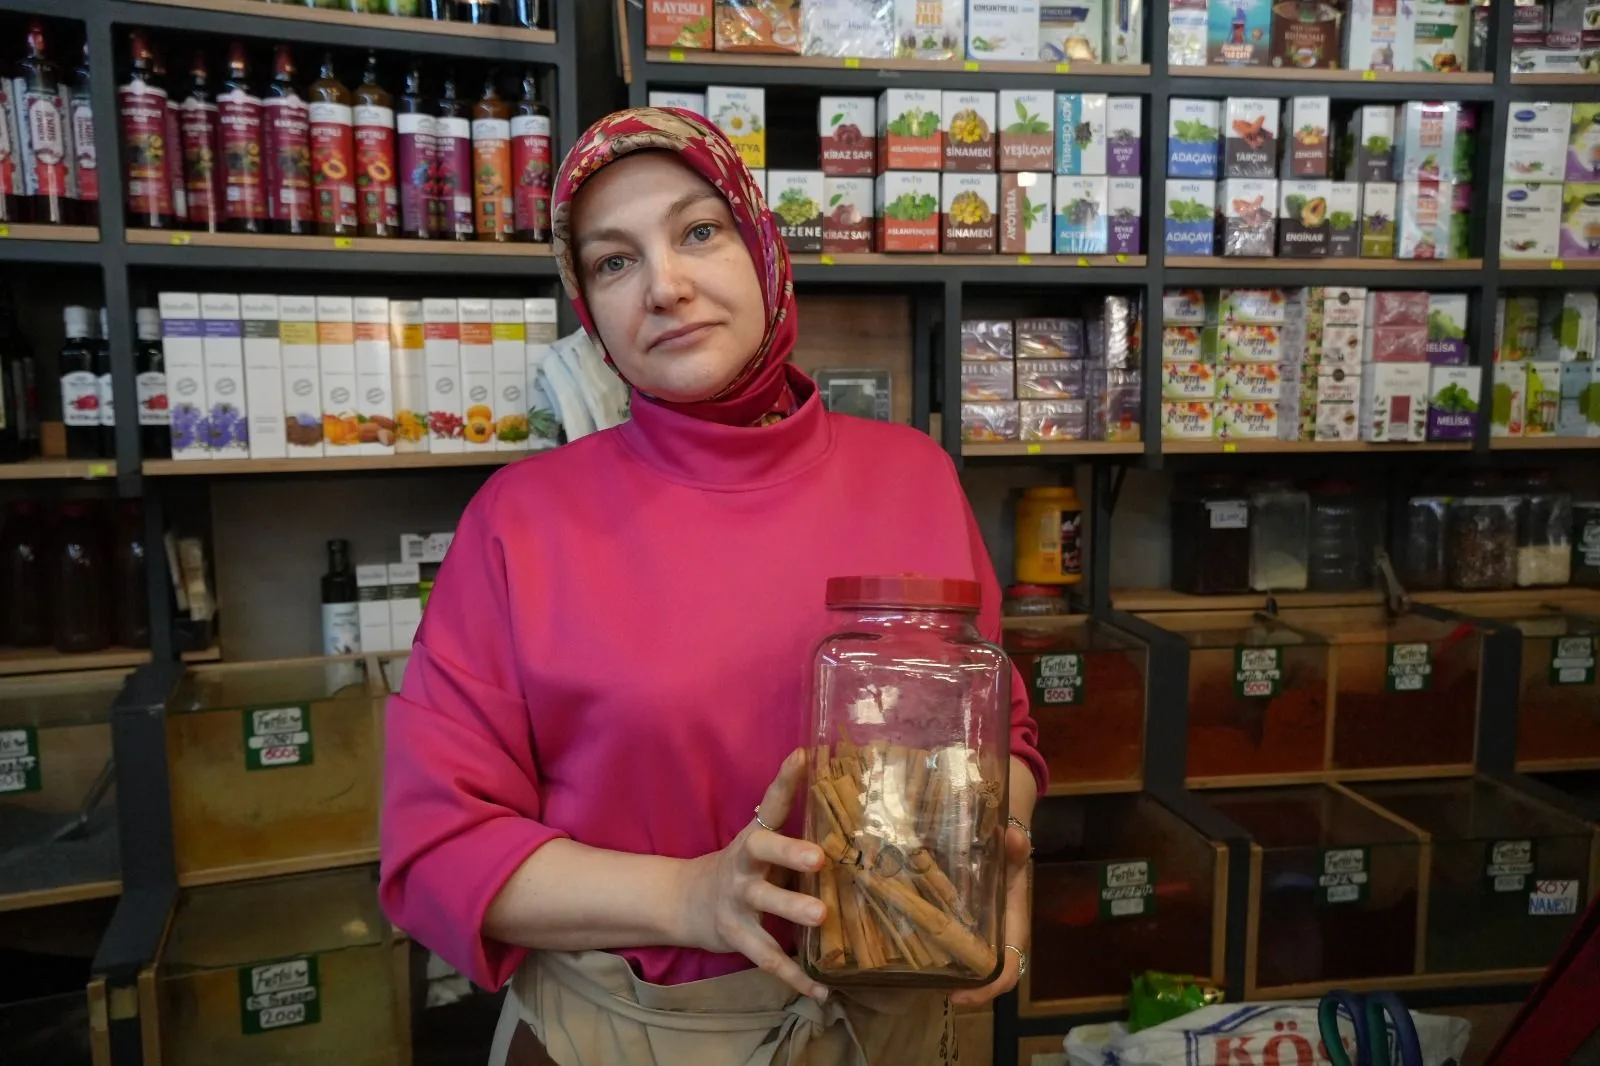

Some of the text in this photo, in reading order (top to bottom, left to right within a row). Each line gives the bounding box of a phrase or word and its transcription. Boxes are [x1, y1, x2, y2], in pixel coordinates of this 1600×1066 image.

[824, 150, 851, 160] KİRAZ
[946, 146, 992, 158] SİNAMEKİ
[1004, 145, 1053, 158] YEŞİLÇAY
[1171, 152, 1216, 165] ADAÇAYI
[778, 226, 822, 238] EZENE
[946, 227, 992, 239] SİNAMEKİ
[1166, 232, 1212, 245] ADAÇAYI
[1437, 415, 1470, 426] MELİSA
